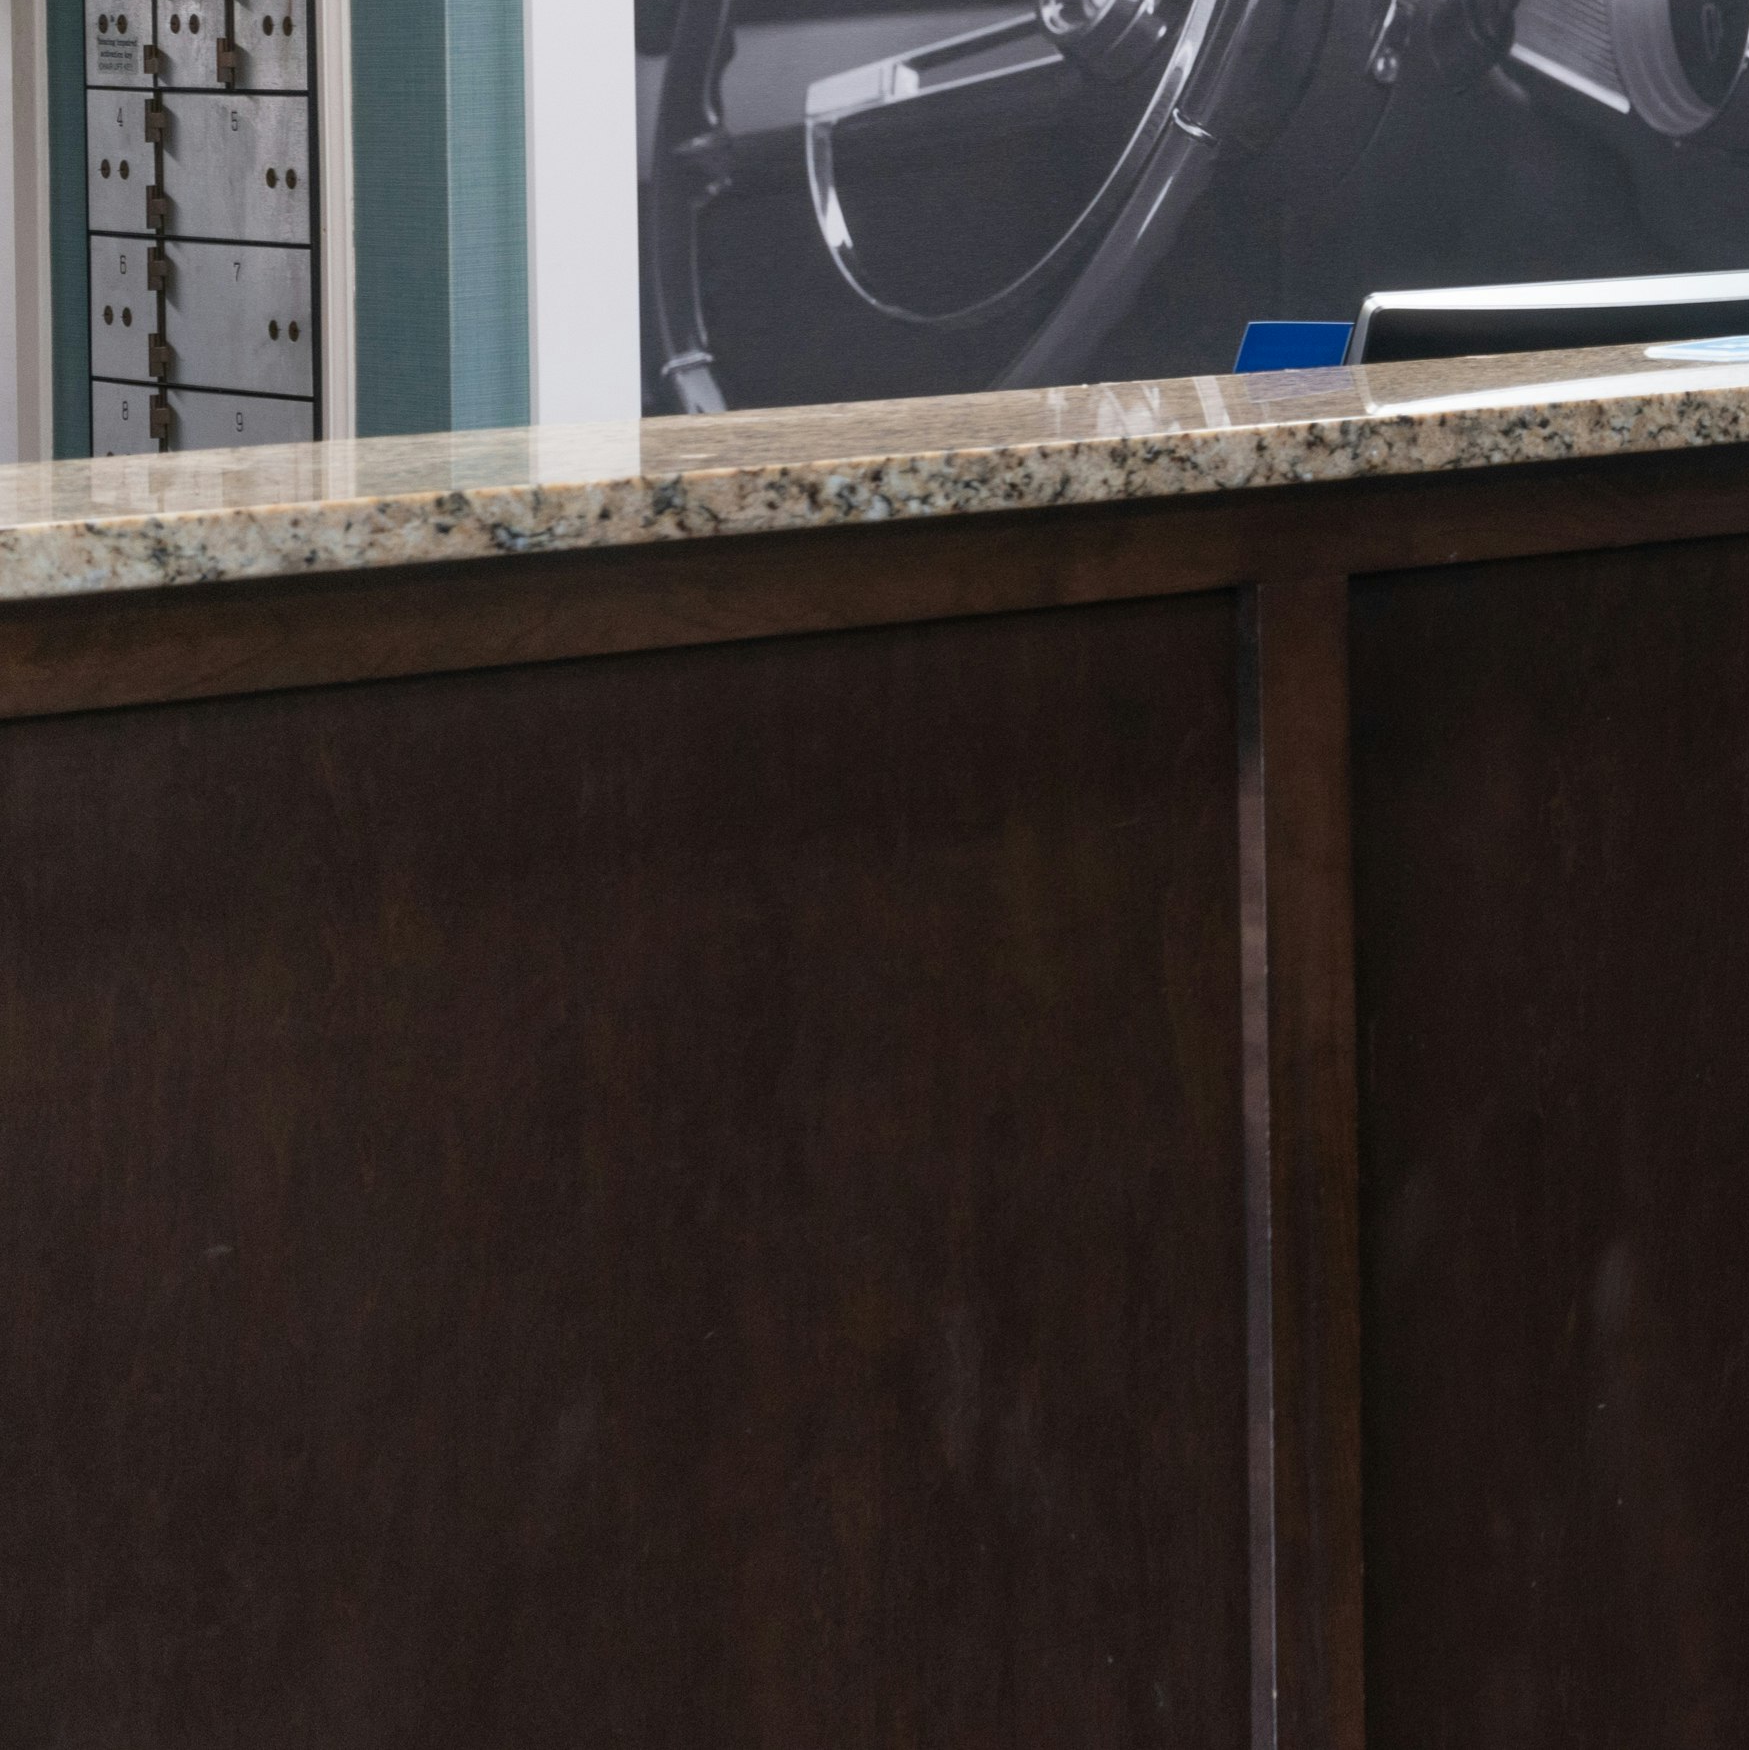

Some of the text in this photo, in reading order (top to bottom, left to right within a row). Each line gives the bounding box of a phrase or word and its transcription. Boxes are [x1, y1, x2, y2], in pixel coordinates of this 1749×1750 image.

[116, 107, 124, 127] 4
[231, 111, 239, 132] 5
[119, 254, 127, 275] 6
[233, 261, 241, 281] 7
[122, 400, 129, 421] 8
[236, 411, 244, 433] 9
